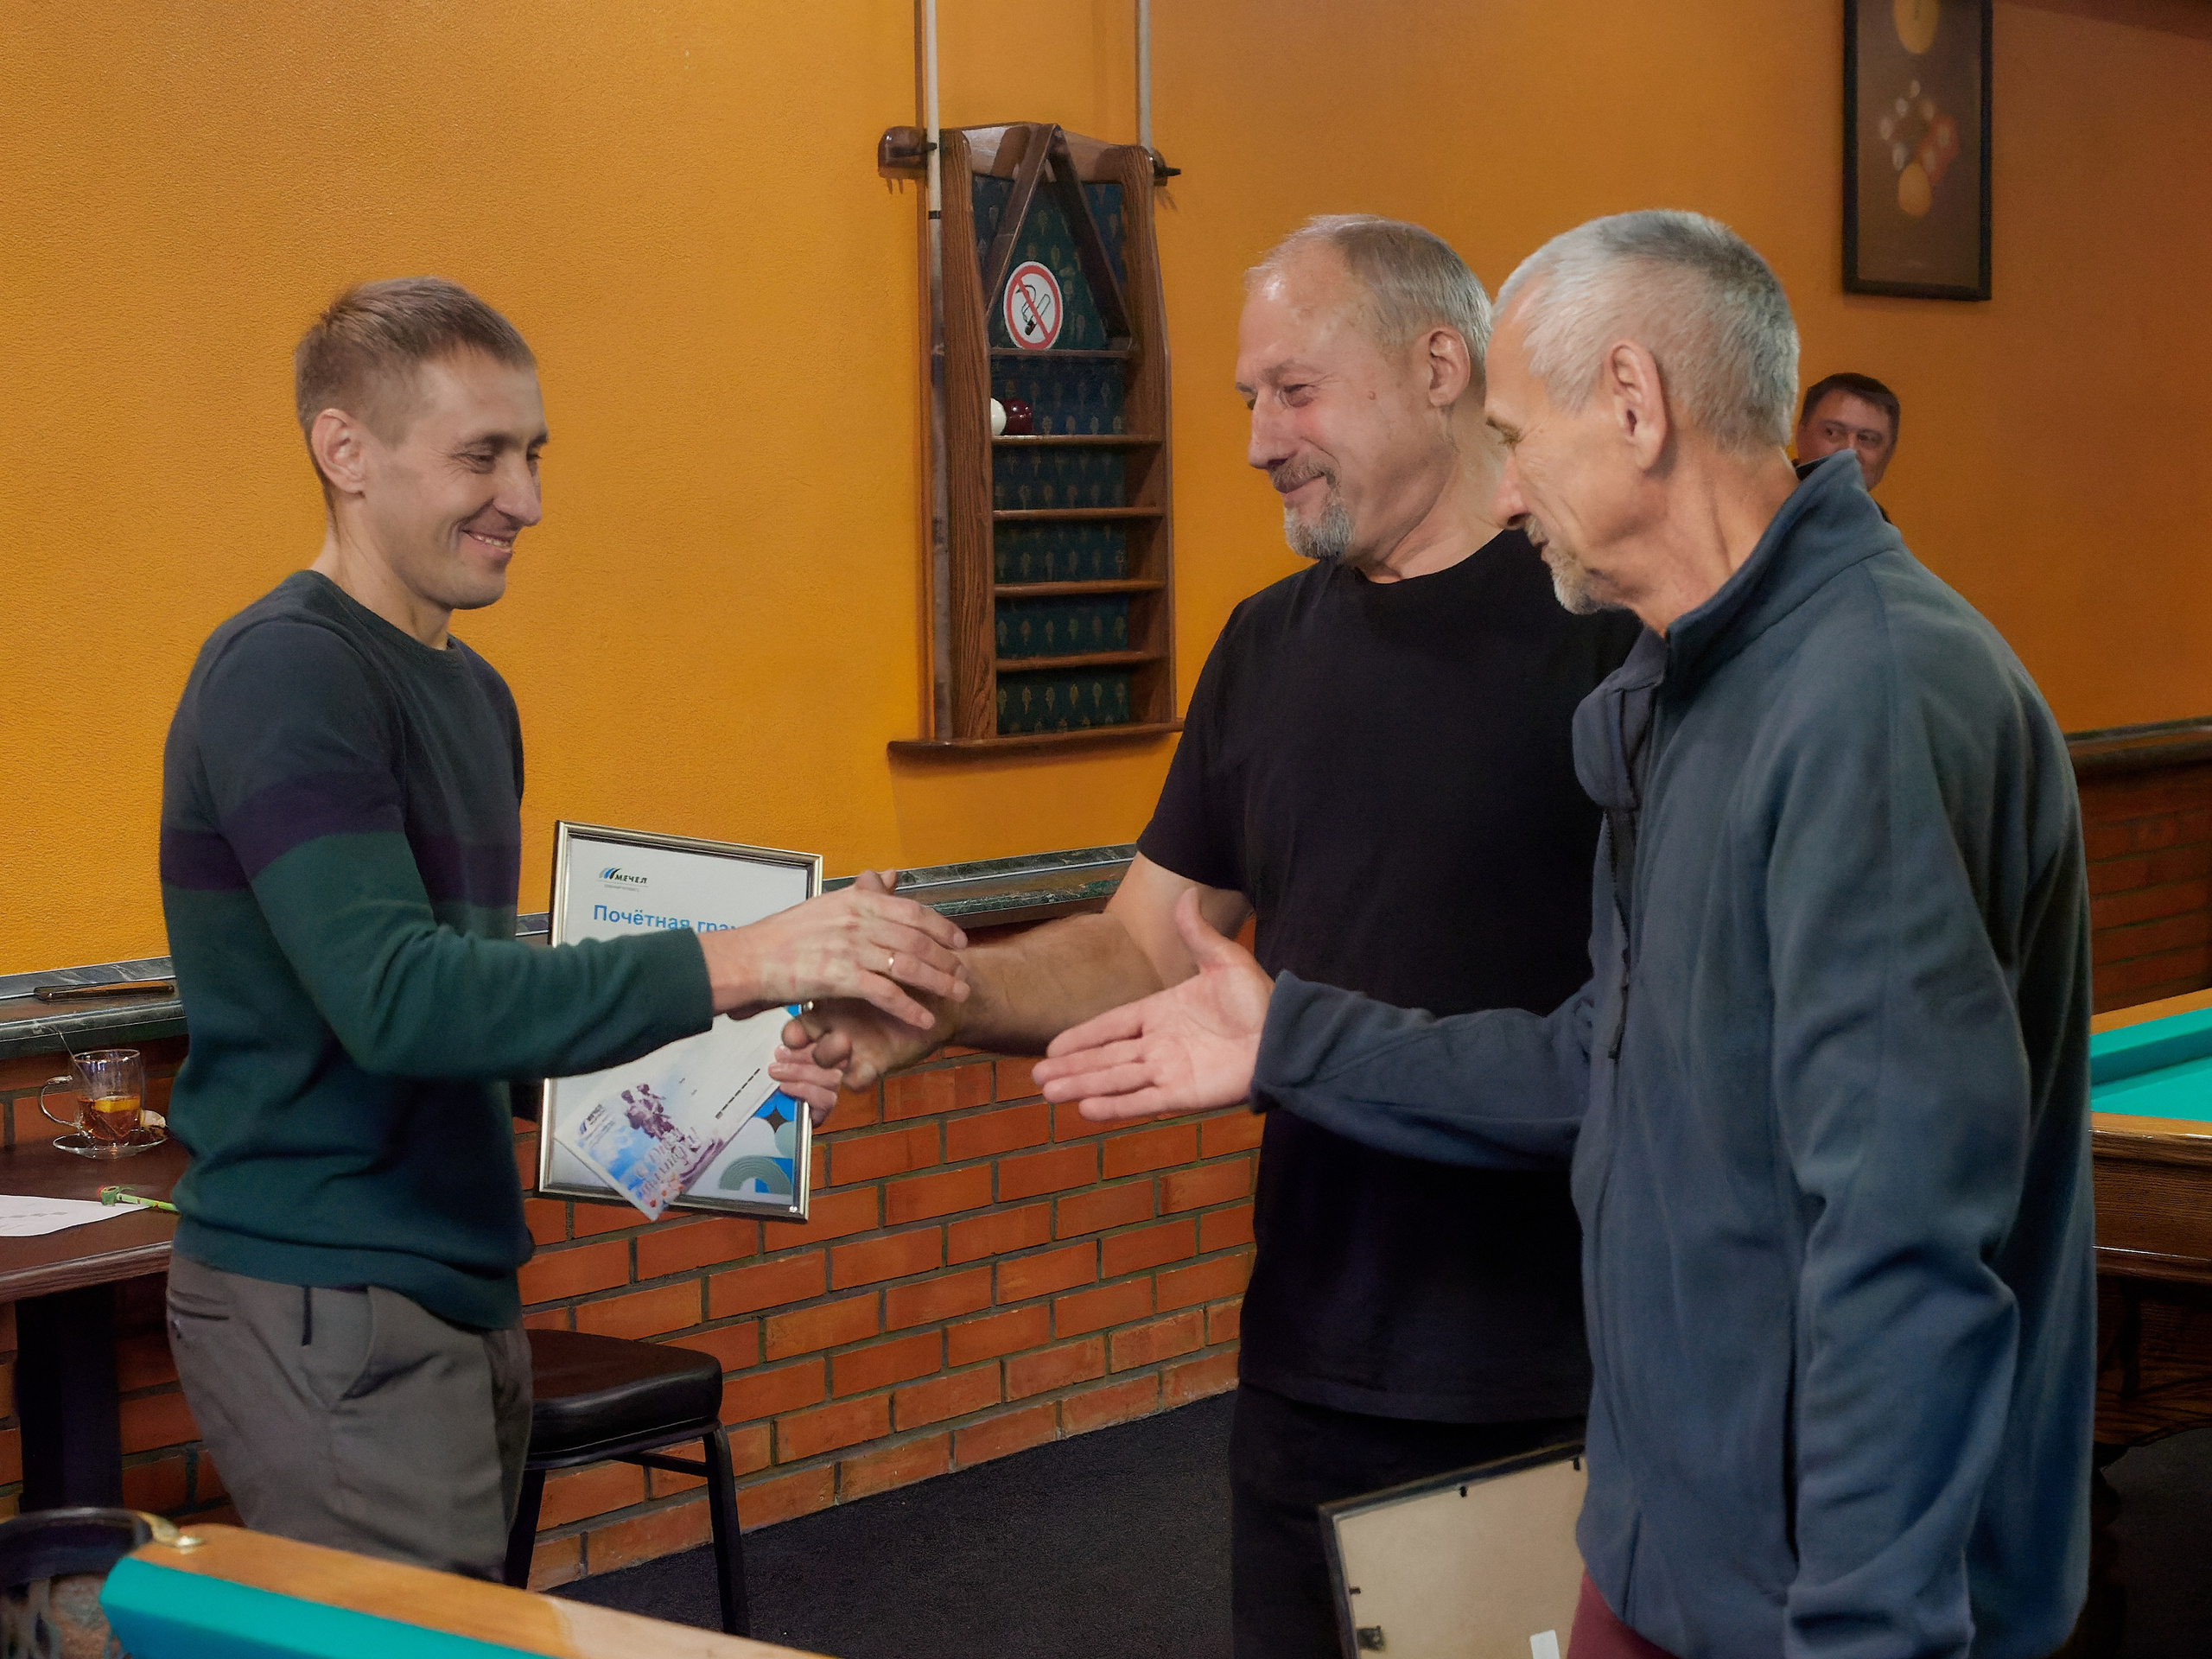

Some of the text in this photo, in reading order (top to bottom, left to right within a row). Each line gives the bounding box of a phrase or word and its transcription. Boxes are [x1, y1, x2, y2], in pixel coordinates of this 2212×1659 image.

[614, 874, 647, 884] МЕЧЕЛ
[594, 905, 736, 933] Почётная гра
